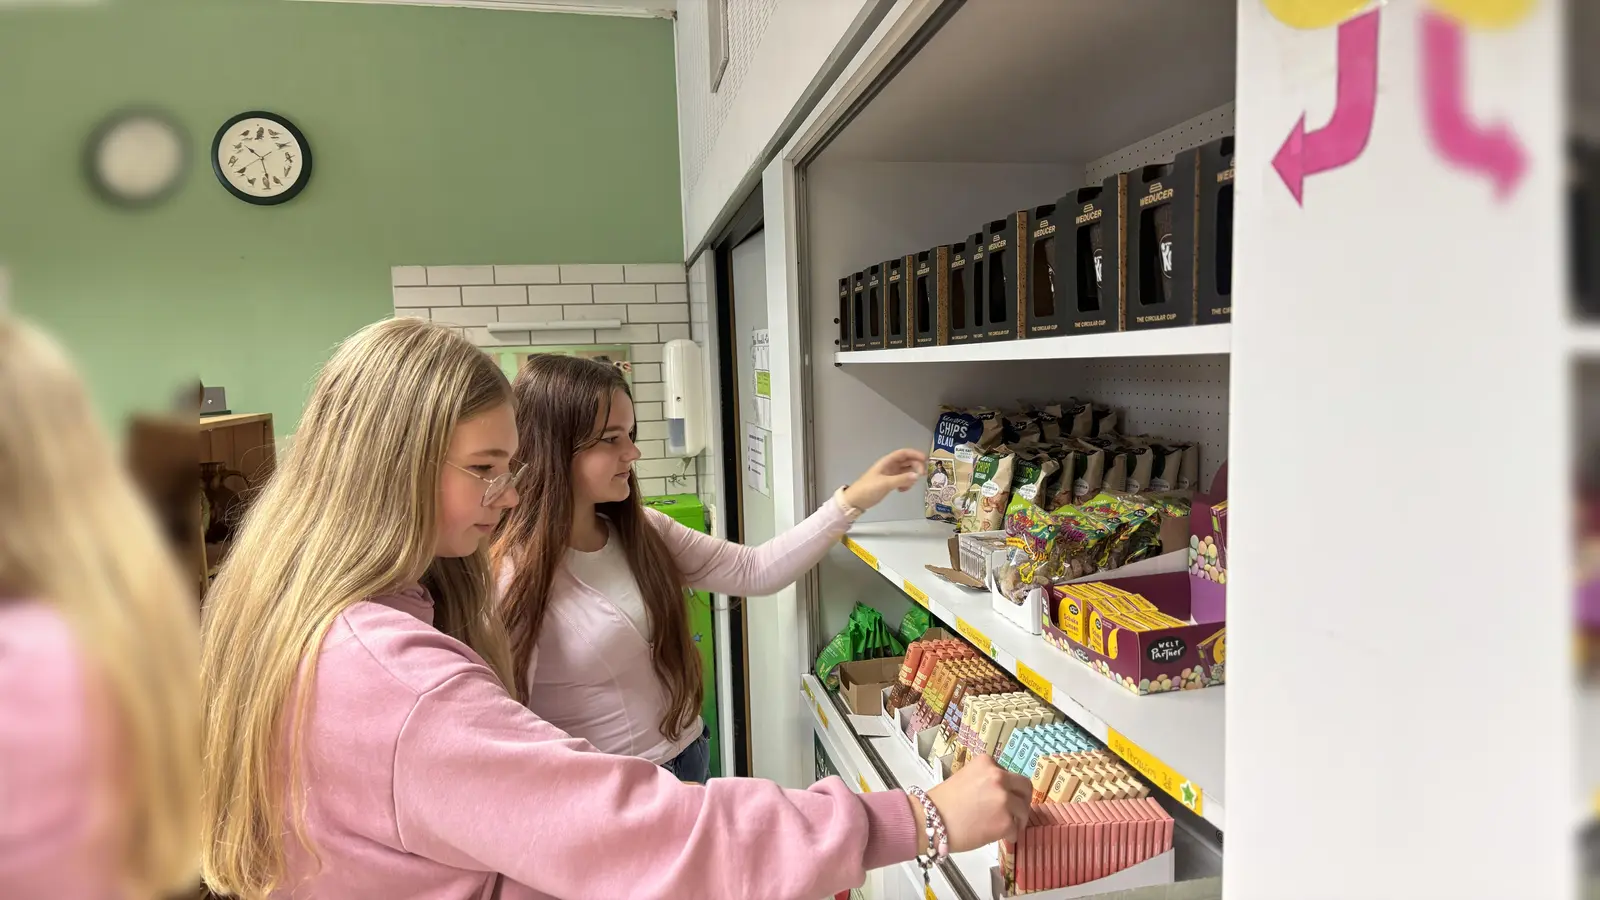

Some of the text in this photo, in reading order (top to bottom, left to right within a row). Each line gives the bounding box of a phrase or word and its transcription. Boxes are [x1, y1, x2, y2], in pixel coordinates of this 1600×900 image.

[1140, 188, 1174, 206] WEDUCER
[1076, 209, 1102, 224] WEDUCER
[1033, 225, 1056, 238] WEDUCER
[1145, 314, 1166, 322] CIRCULAR
[939, 421, 968, 439] CHIPS
[937, 434, 954, 448] BLAU
[1158, 640, 1180, 649] WELT
